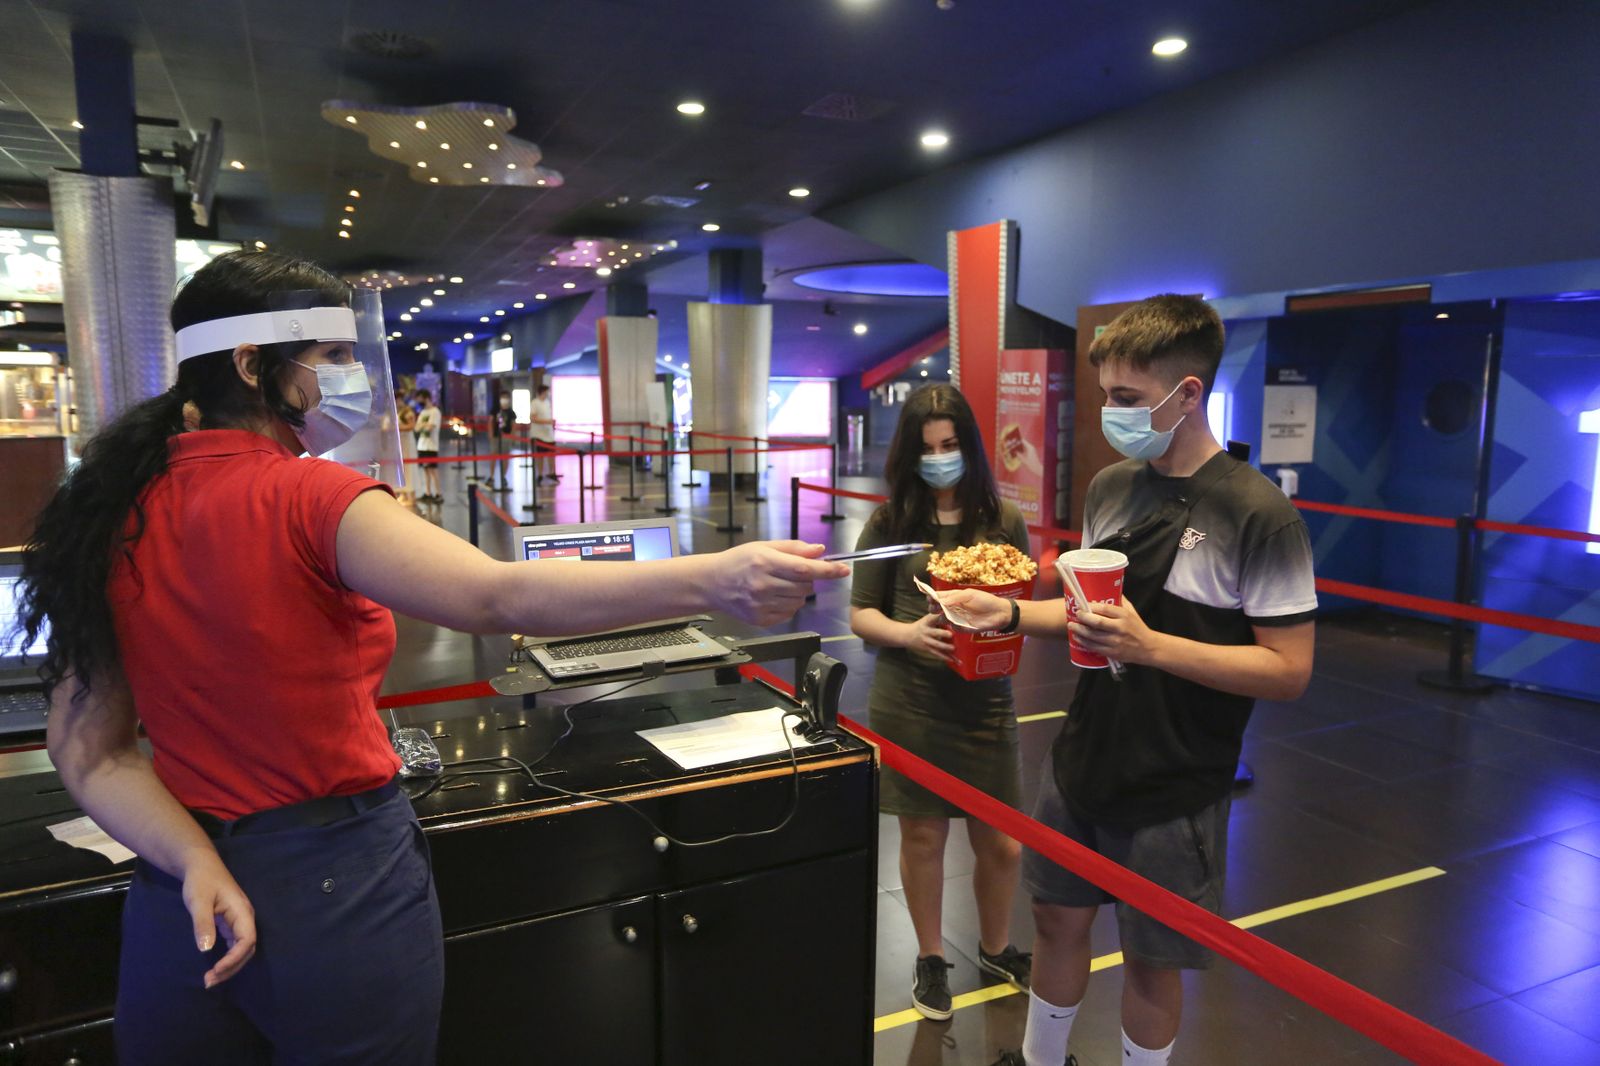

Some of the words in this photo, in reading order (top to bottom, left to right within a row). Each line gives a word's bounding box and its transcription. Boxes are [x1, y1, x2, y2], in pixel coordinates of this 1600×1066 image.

[1000, 370, 1030, 385] ÚNETE
[1032, 372, 1041, 385] A
[612, 535, 630, 543] 18:15
